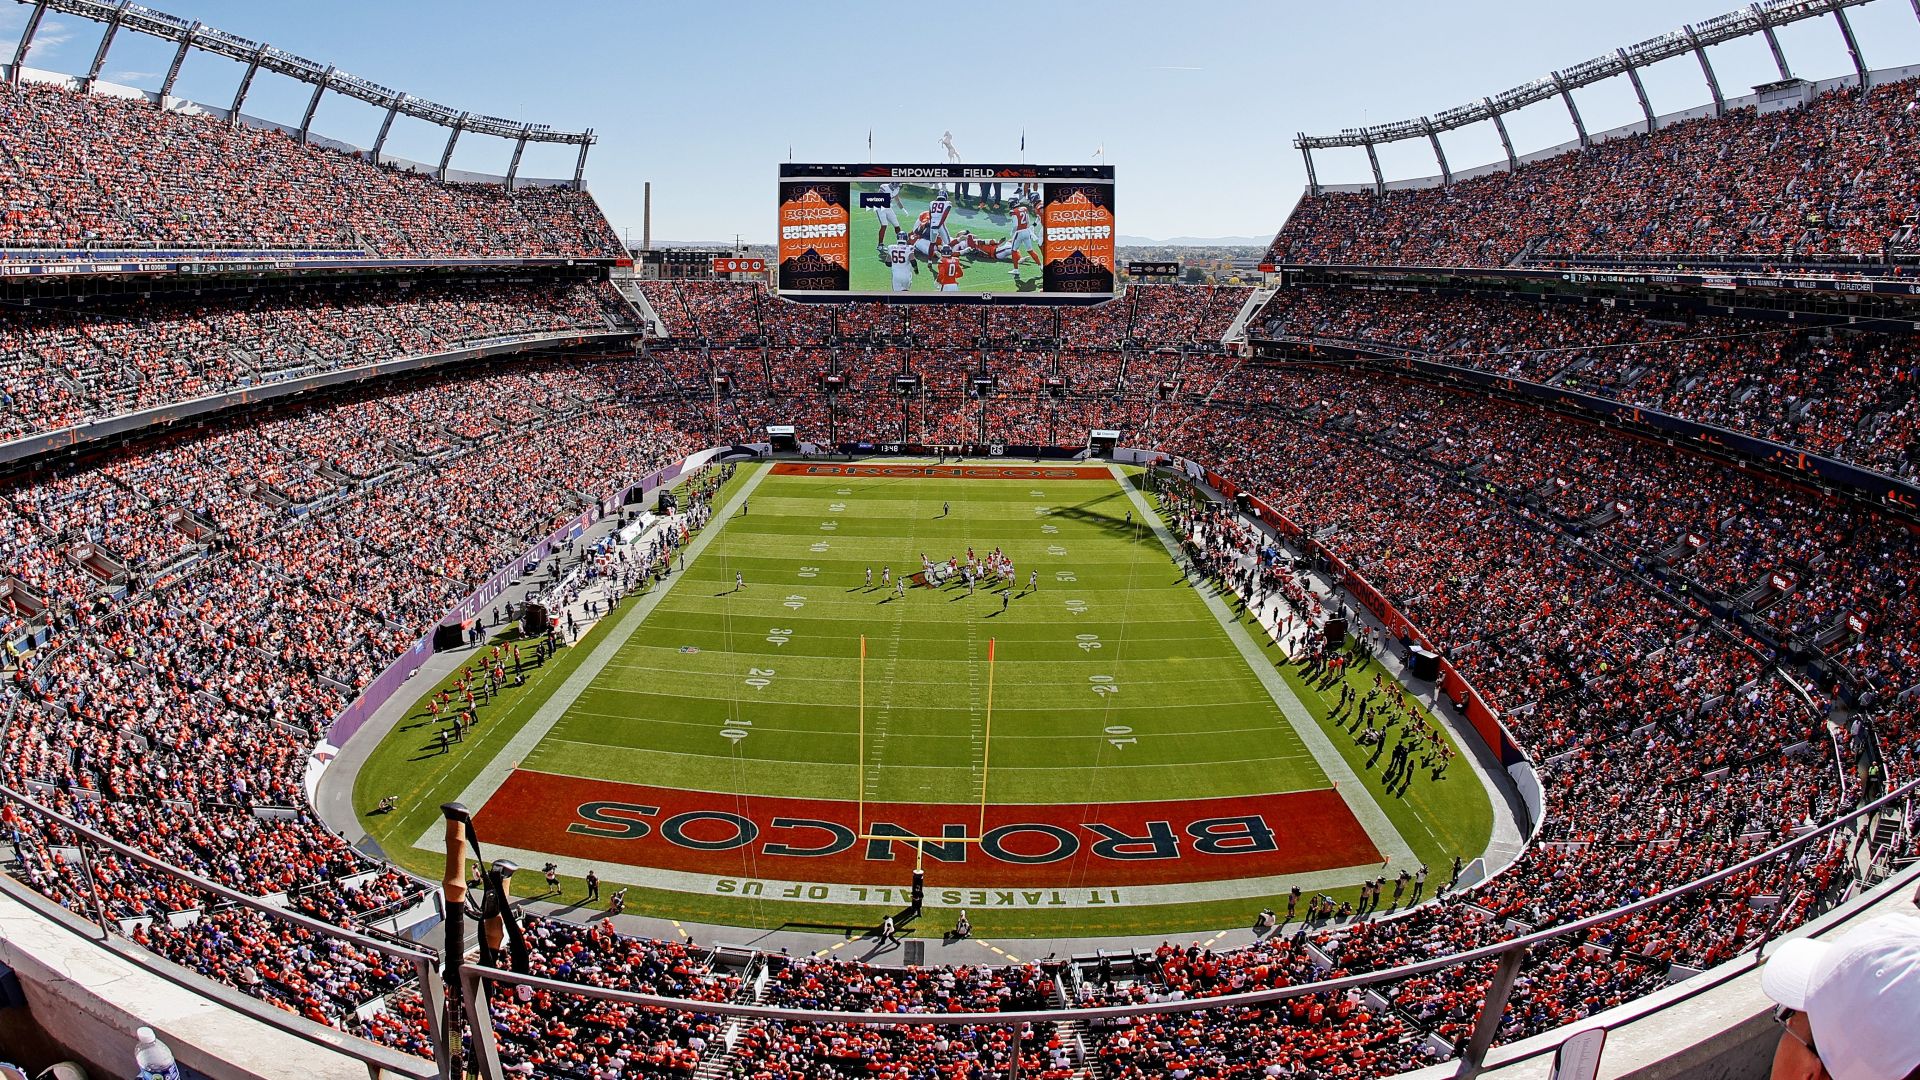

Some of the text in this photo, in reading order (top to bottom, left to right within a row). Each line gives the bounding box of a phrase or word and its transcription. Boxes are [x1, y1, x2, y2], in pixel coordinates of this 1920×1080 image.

[891, 168, 995, 178] EMPOWER FIELD
[931, 203, 945, 214] 89
[782, 223, 847, 233] BRONCOS
[1047, 225, 1111, 235] BRONCOS
[782, 230, 846, 240] COUNTRY
[1047, 232, 1110, 241] COUNTRY
[891, 250, 906, 264] 65
[16, 266, 31, 274] ELAM
[97, 264, 122, 272] SHANAHAN
[202, 264, 206, 272] 7
[948, 263, 956, 277] 0
[1799, 281, 1817, 289] MILLER
[1840, 282, 1871, 291] 73 FLETCHER
[881, 444, 899, 453] 13:48
[807, 466, 1078, 477] BRONCOS
[798, 566, 820, 577] 50
[1056, 571, 1077, 582] 50
[459, 549, 539, 622] THE MILE HIGH CITY
[1345, 572, 1386, 617] BRONCOS
[1065, 600, 1088, 612] 40
[766, 628, 793, 643] 30
[1075, 634, 1102, 649] 30
[745, 667, 776, 686] 20
[1088, 675, 1119, 693] 20
[720, 719, 753, 738] 10
[1104, 725, 1138, 745] 10
[566, 801, 1279, 864] BRONCOS
[716, 879, 1121, 906] IT TAKES ALL OF US
